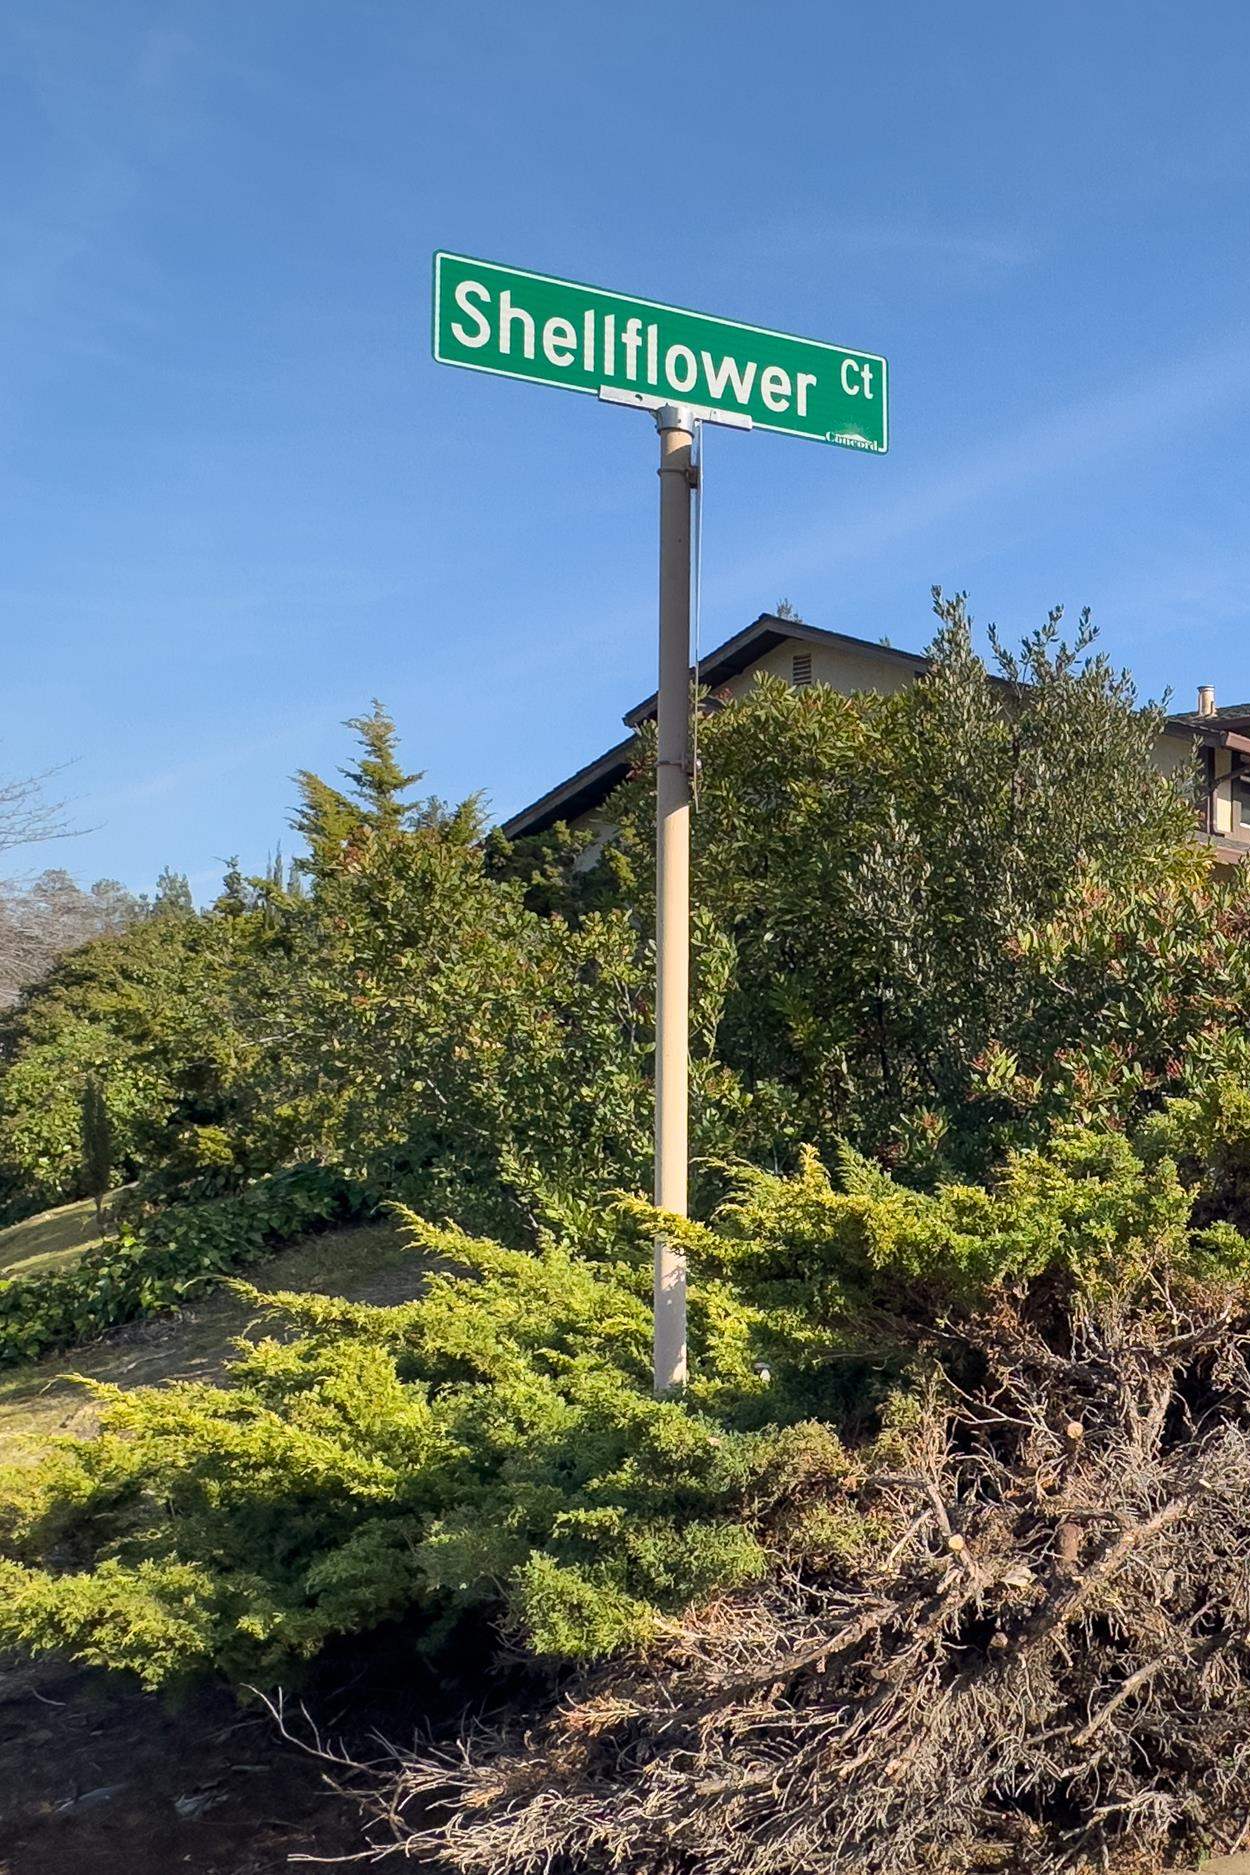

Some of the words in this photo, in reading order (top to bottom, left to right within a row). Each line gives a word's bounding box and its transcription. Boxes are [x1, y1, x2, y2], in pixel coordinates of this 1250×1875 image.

[451, 280, 817, 417] Shellflower
[840, 358, 874, 400] Ct
[825, 431, 878, 451] Concord
